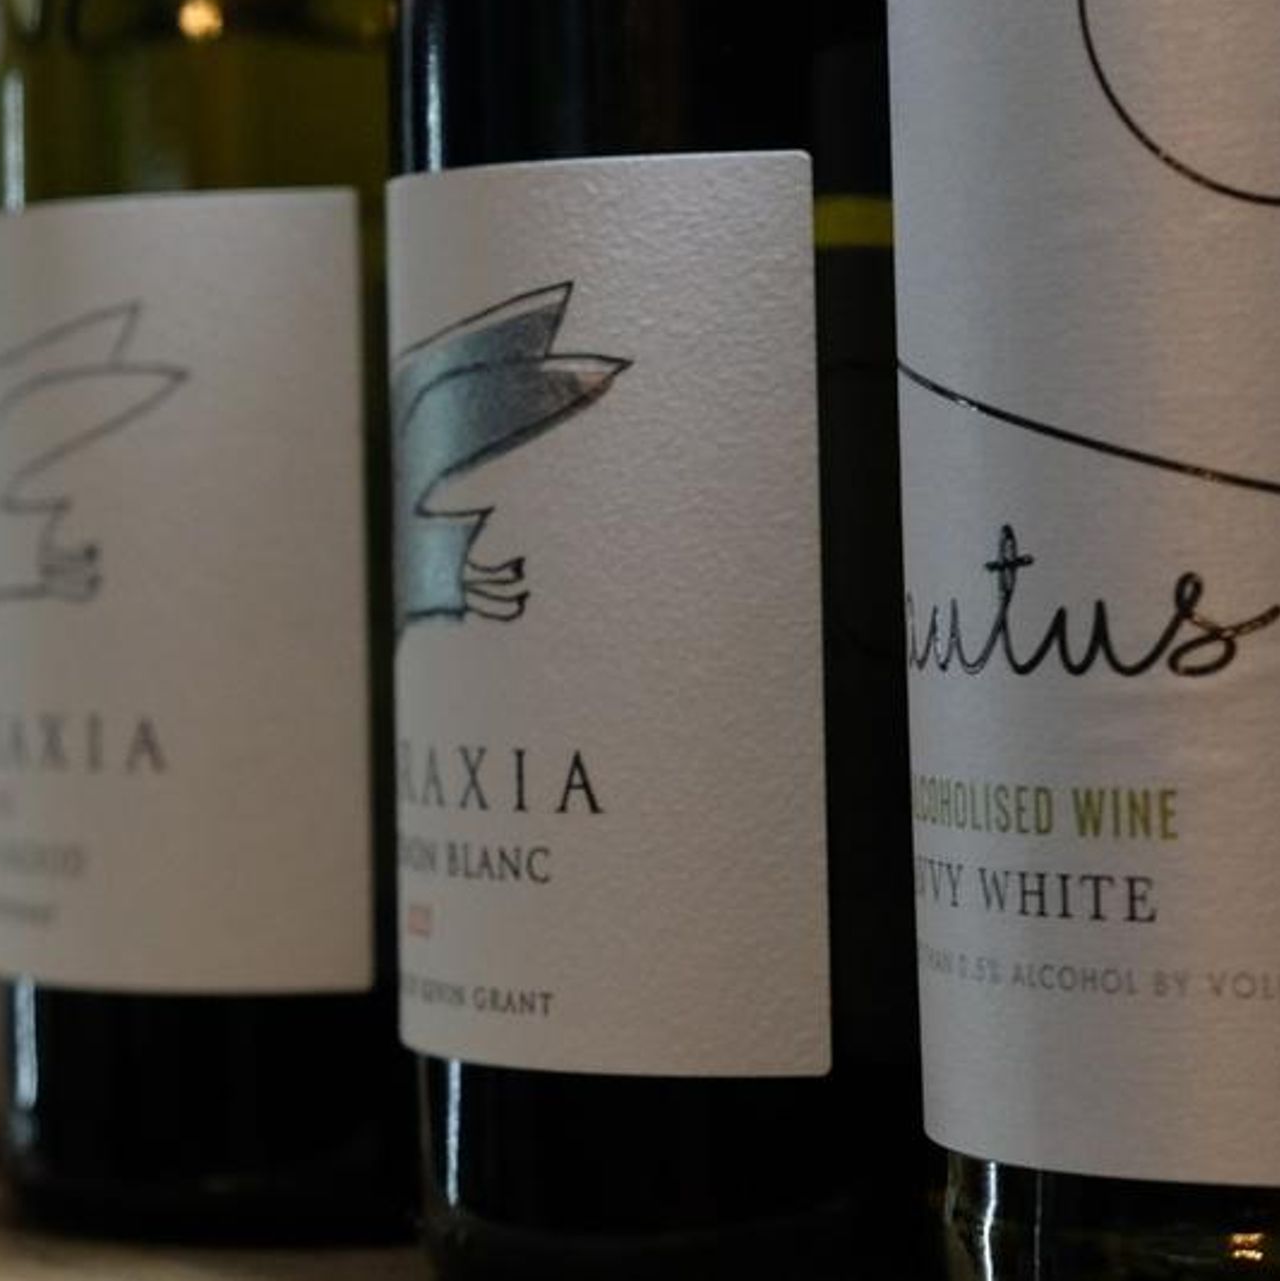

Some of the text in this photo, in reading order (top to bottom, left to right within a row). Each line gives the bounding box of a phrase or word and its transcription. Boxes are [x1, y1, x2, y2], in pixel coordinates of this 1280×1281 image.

[1072, 786, 1180, 841] WINE
[446, 842, 552, 885] BLANC
[978, 867, 1158, 923] WHITE
[1011, 962, 1138, 997] ALCOHOL
[1153, 971, 1189, 998] BY
[473, 986, 554, 1018] GRANT
